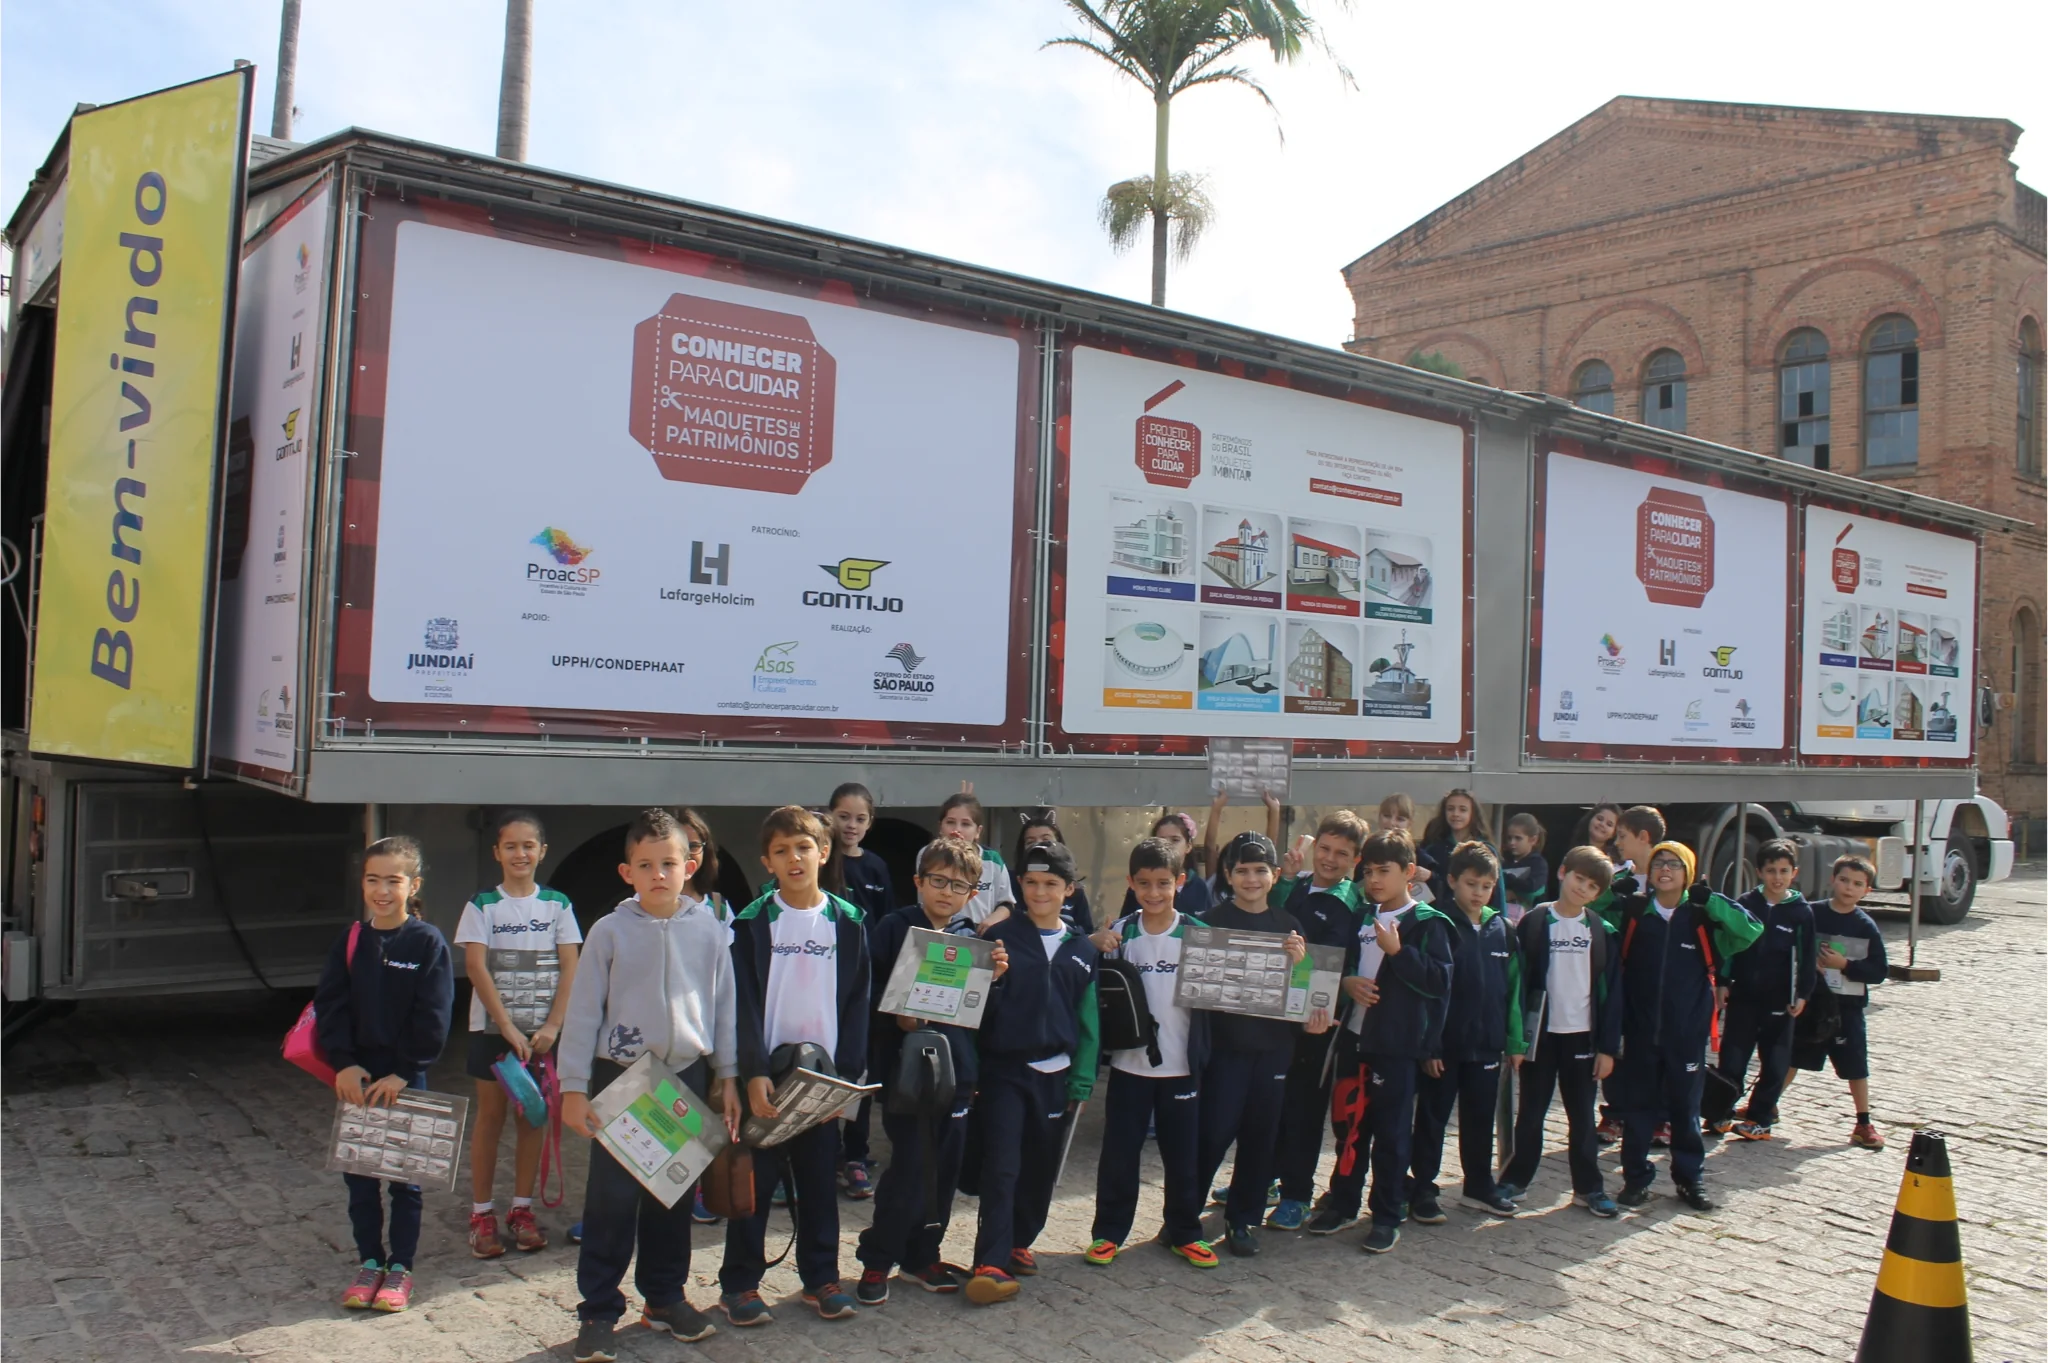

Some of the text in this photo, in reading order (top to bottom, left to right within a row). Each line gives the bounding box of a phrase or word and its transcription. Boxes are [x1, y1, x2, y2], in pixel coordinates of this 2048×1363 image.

[671, 332, 802, 374] CONHECER
[684, 405, 800, 438] MAQUETES DE
[91, 171, 167, 690] Bem-vindo
[1149, 423, 1188, 439] PROJETO
[666, 426, 799, 460] PATRIMÔNIOS
[1145, 434, 1192, 451] CONHECER
[1222, 442, 1252, 457] BRASIL
[1157, 448, 1180, 460] PARA
[1151, 458, 1185, 473] CUIDAR
[1651, 511, 1702, 533] CONHECER
[1656, 556, 1696, 572] MAQUETES
[527, 563, 600, 584] ProacSP
[1649, 568, 1702, 586] PATRIMÔNIOS
[660, 587, 755, 606] LafargeHolcim
[802, 590, 903, 613] GONTIJO
[521, 613, 549, 622] APOIO:
[407, 652, 474, 669] JUNDIAÍ
[552, 655, 685, 673] UPPH/CONDEPHAAT
[754, 655, 795, 674] Asas
[1703, 667, 1743, 680] GONTIJO
[873, 677, 934, 692] SÃO PAULO
[717, 701, 839, 712] contato@conhecerparacuidar.com.br
